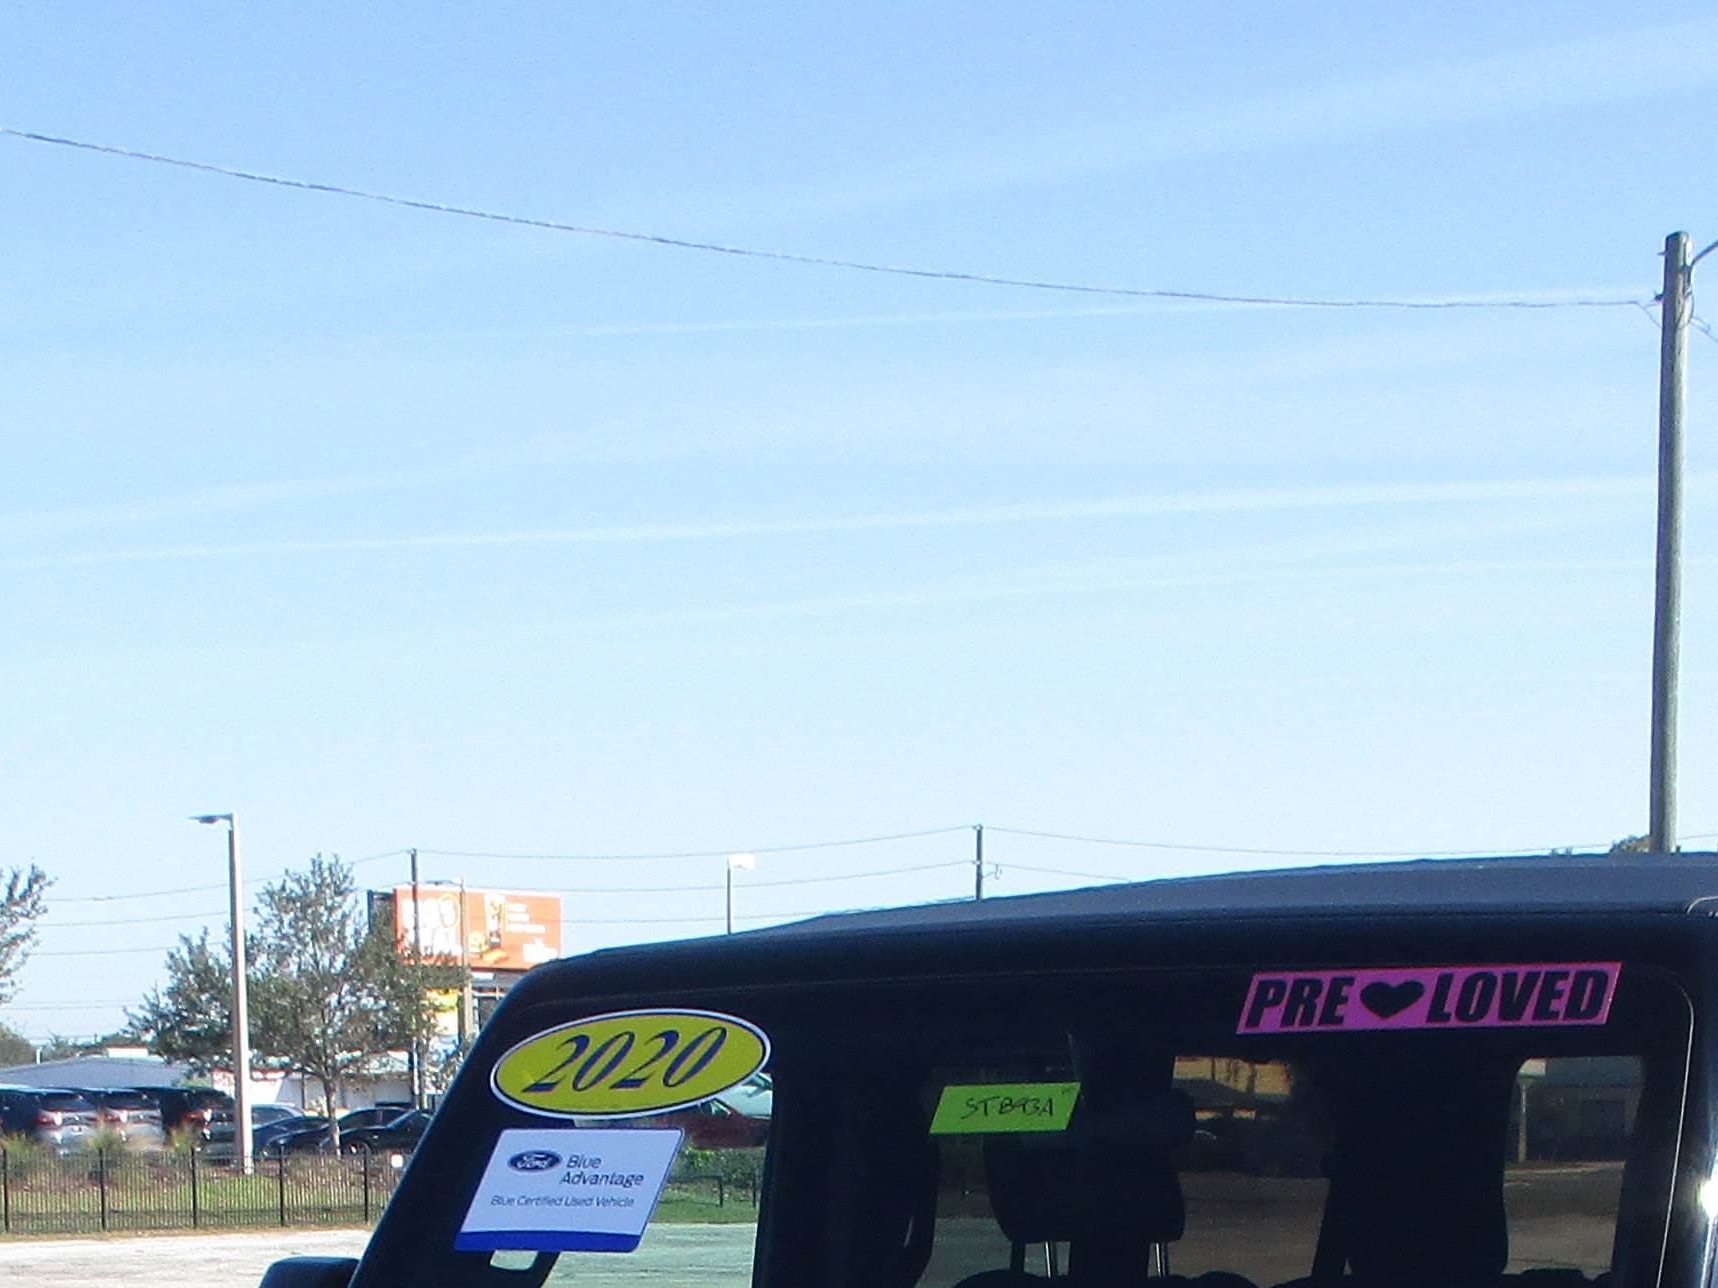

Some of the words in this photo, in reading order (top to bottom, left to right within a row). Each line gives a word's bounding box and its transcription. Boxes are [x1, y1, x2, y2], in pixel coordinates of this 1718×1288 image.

[1245, 976, 1355, 1029] PRE
[1425, 970, 1610, 1024] LOVED
[521, 1026, 728, 1093] 2020
[566, 1154, 602, 1169] Blue
[559, 1171, 644, 1188] Advantage
[490, 1195, 515, 1207] Blue
[516, 1195, 562, 1207] Certified
[563, 1195, 594, 1208] Used
[595, 1195, 635, 1208] Vehicle
